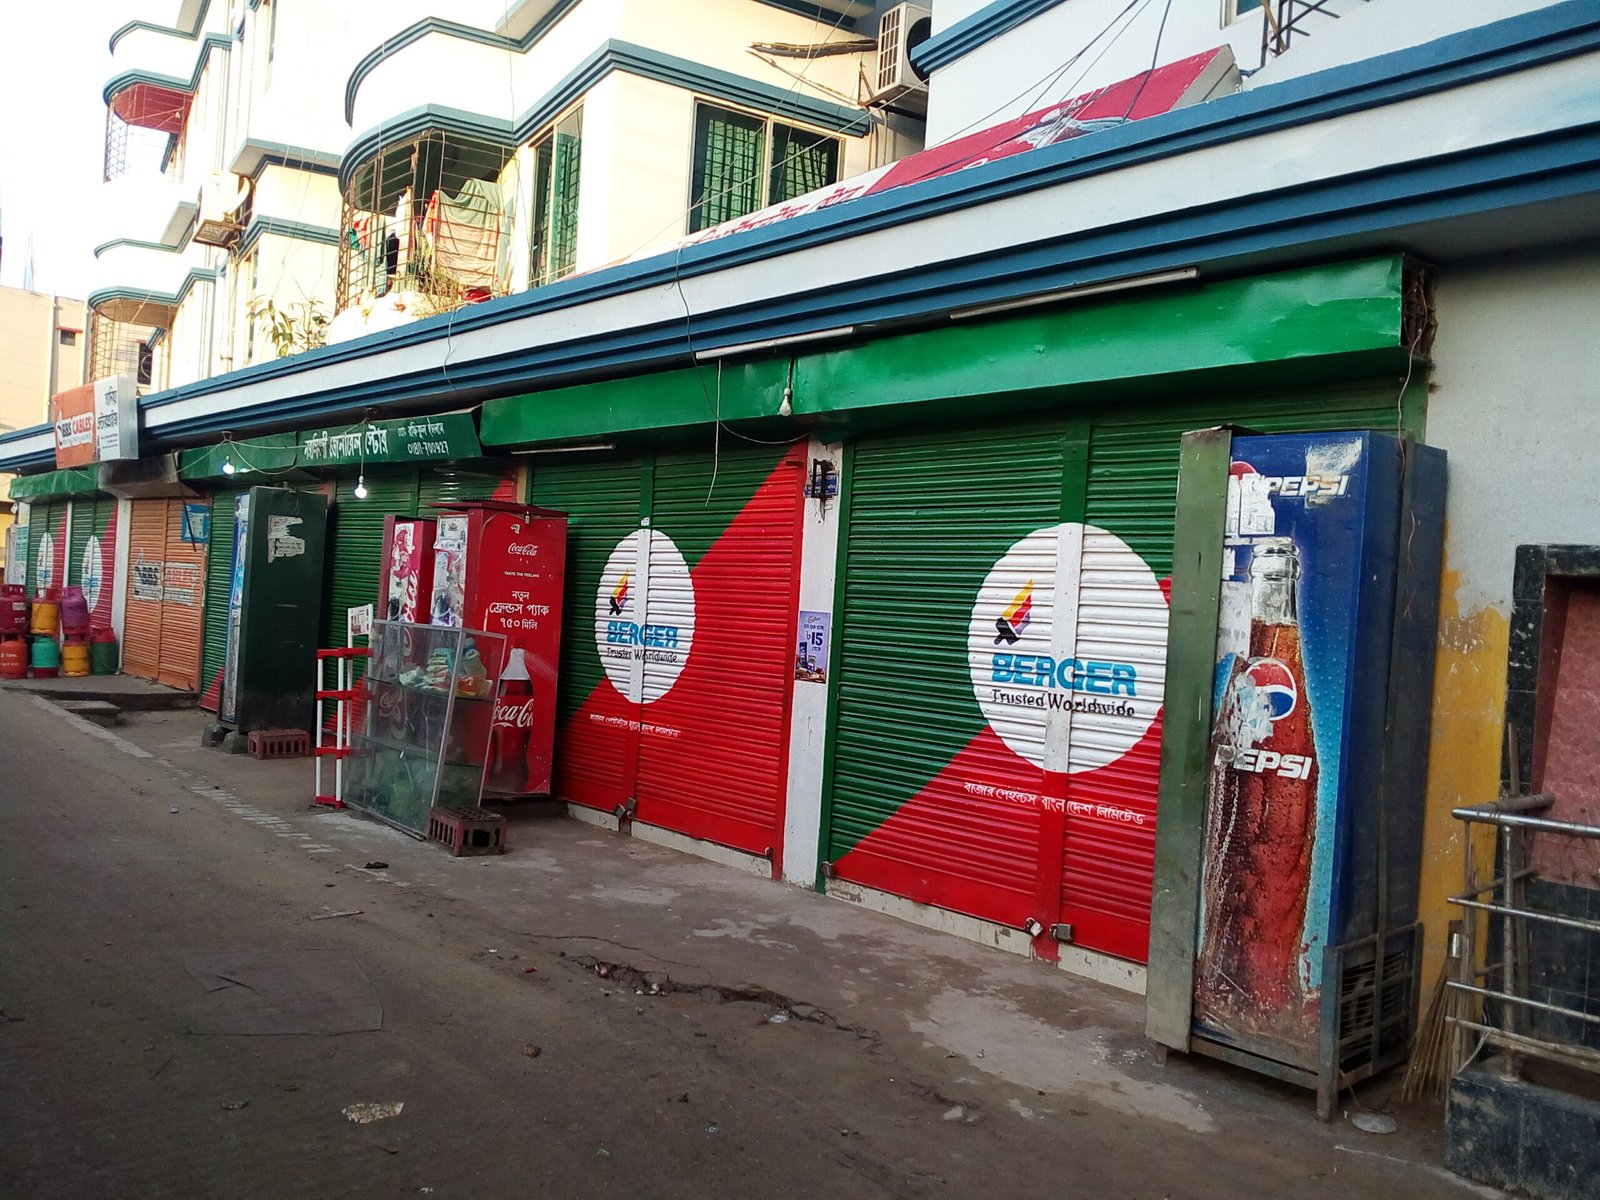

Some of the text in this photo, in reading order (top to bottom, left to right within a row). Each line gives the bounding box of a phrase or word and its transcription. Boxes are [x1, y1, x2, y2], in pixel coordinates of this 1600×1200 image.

[1266, 474, 1350, 497] PEPSI
[511, 590, 530, 602] নতুন
[526, 603, 550, 616] প্যাক
[500, 617, 538, 630] ৭৫০ মিলি
[607, 620, 679, 648] BERGER
[634, 649, 678, 663] Worldwide
[992, 652, 1137, 697] BERGER
[991, 689, 1136, 718] Trusted Worldwide
[1096, 804, 1147, 826] লিমিটেড
